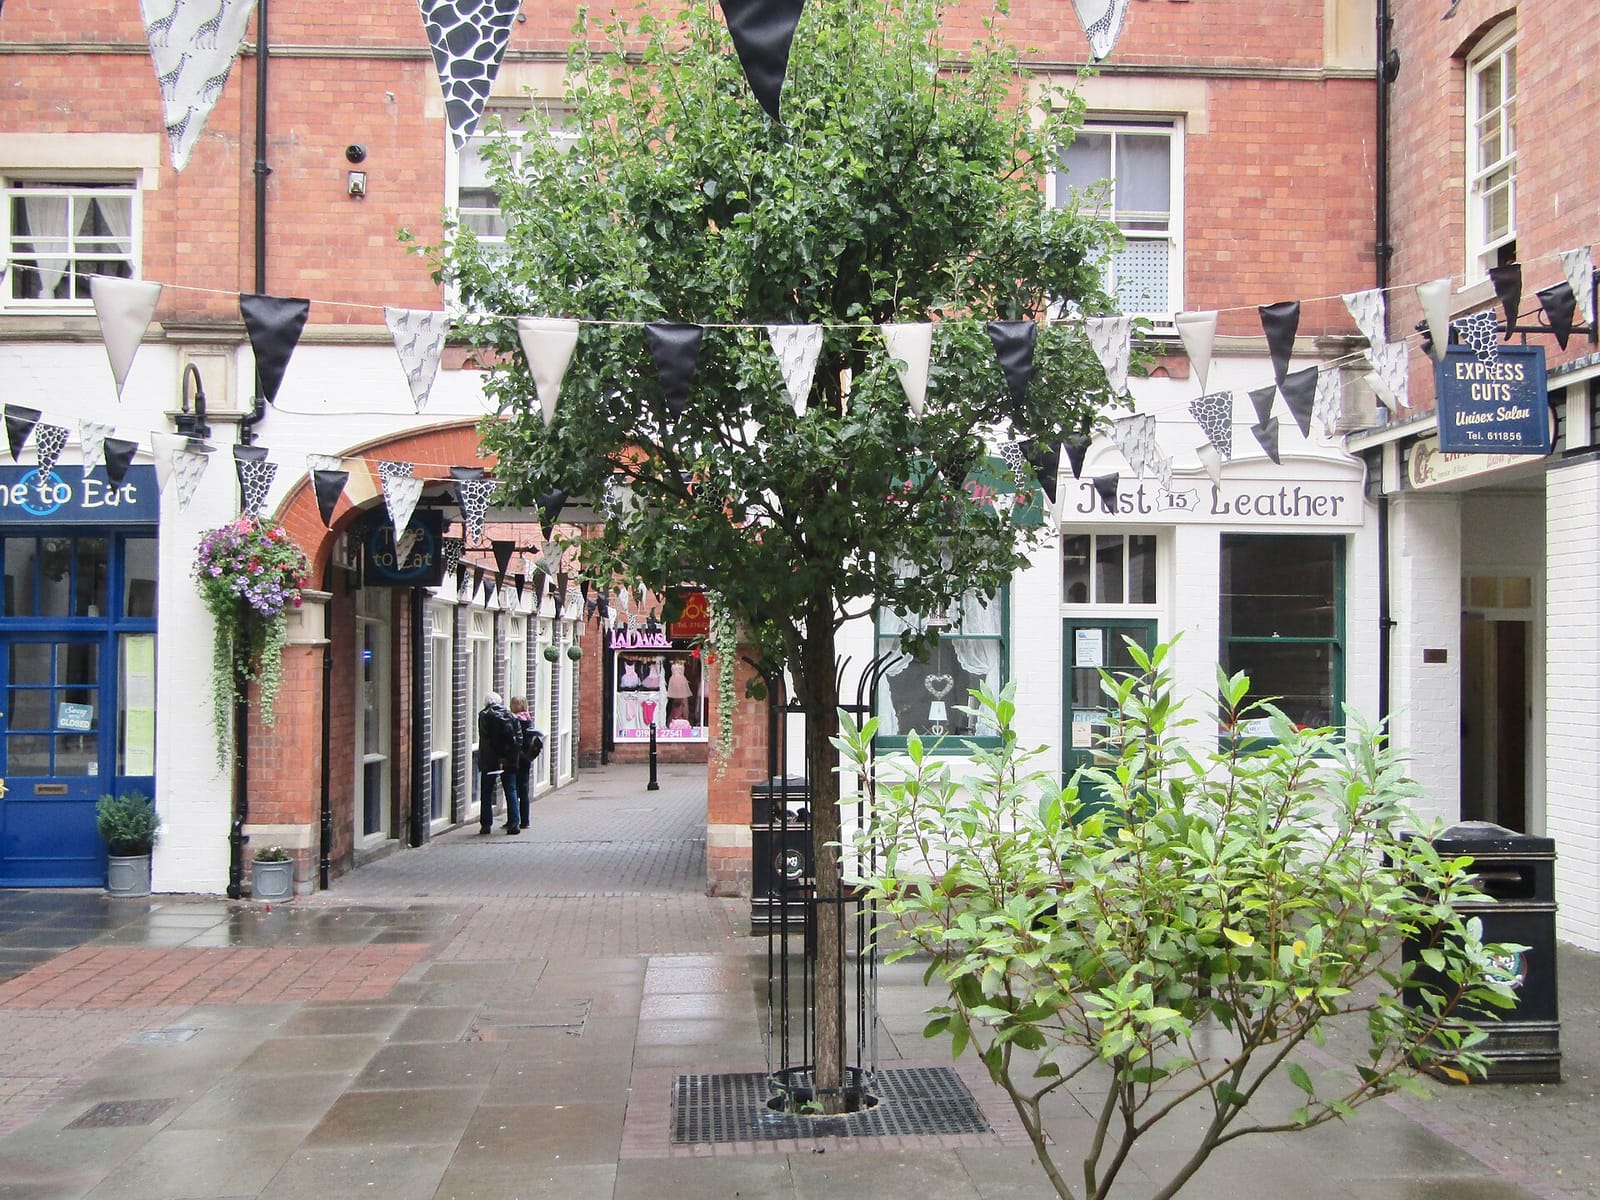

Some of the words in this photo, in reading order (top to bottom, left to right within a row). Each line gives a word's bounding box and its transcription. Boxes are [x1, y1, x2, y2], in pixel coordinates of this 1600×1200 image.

[1455, 362, 1525, 381] EXPRESS
[1471, 383, 1512, 402] CUTS
[1455, 411, 1494, 426] Unisex
[1496, 405, 1530, 421] Salon
[1466, 431, 1484, 440] Tel.
[1487, 431, 1522, 441] 611856
[36, 482, 73, 504] to
[81, 479, 137, 508] Eat
[1167, 494, 1188, 509] 15
[1209, 484, 1345, 518] Leather
[372, 553, 394, 567] to
[60, 718, 90, 728] CLOSED
